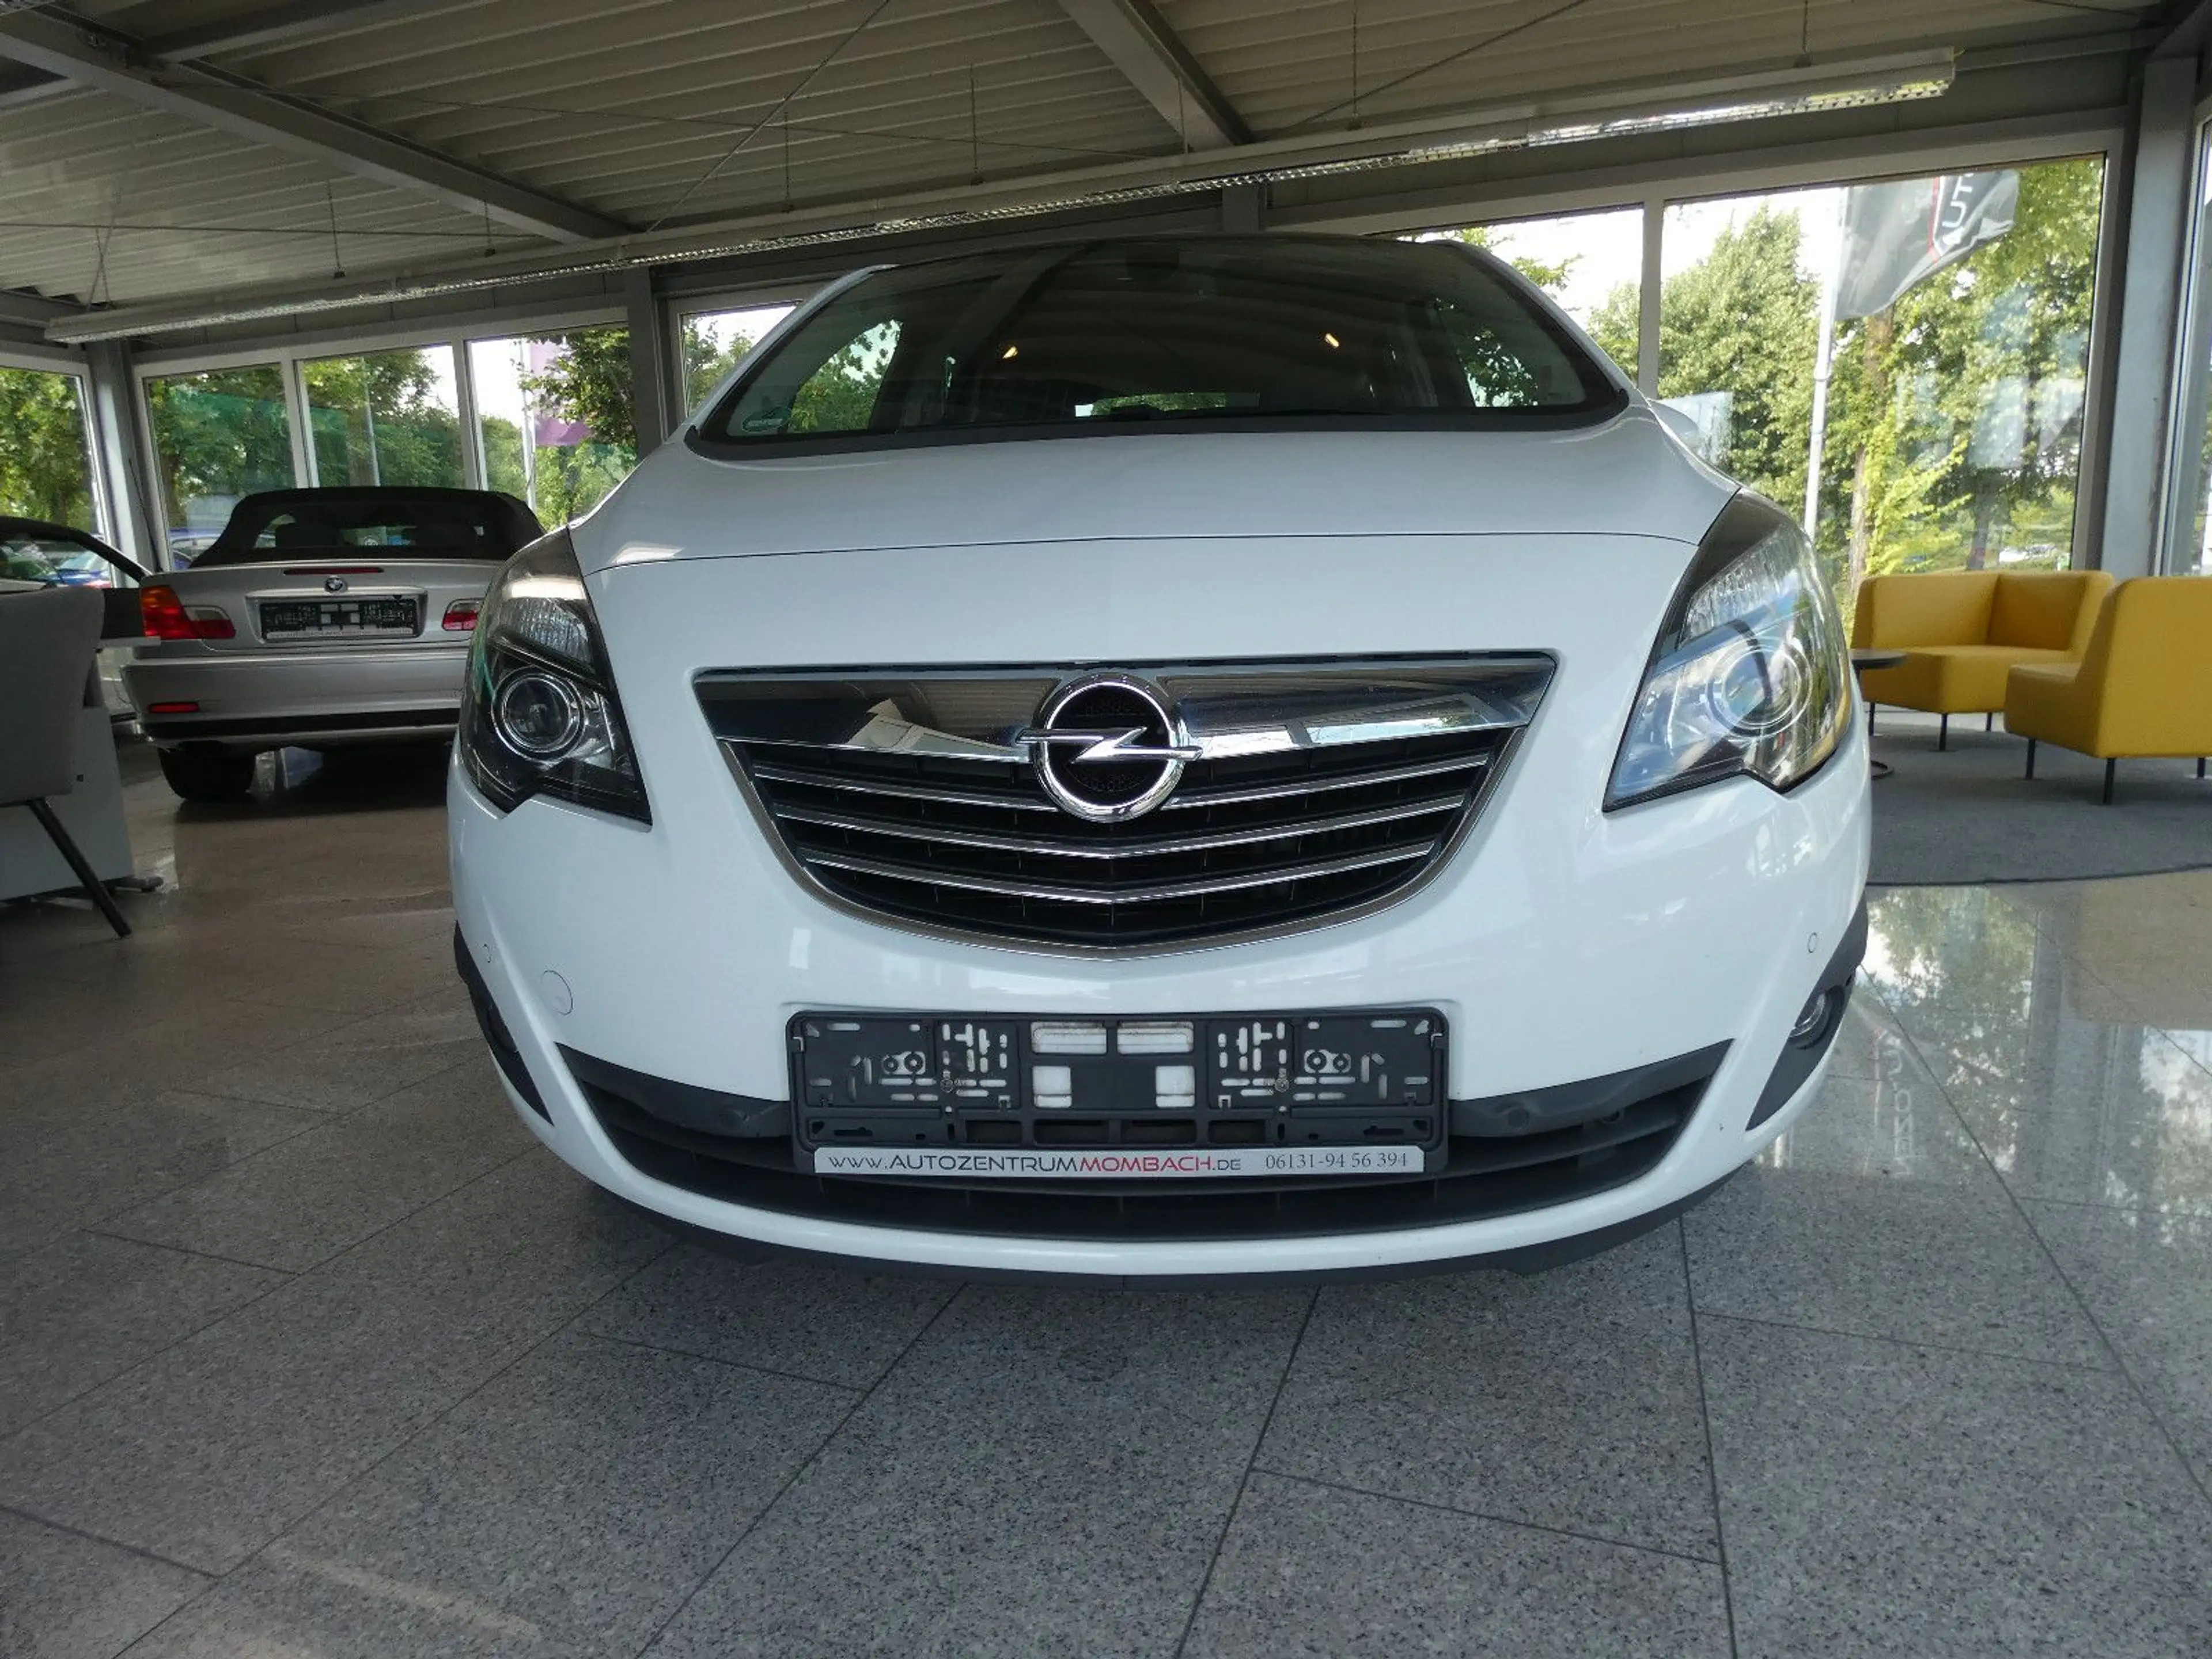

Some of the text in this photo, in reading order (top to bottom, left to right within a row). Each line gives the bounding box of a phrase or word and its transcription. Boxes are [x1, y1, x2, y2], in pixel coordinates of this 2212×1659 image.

[1266, 1153, 1345, 1169] 06131-94
[1351, 1152, 1372, 1168] 56
[1376, 1152, 1407, 1167] 394
